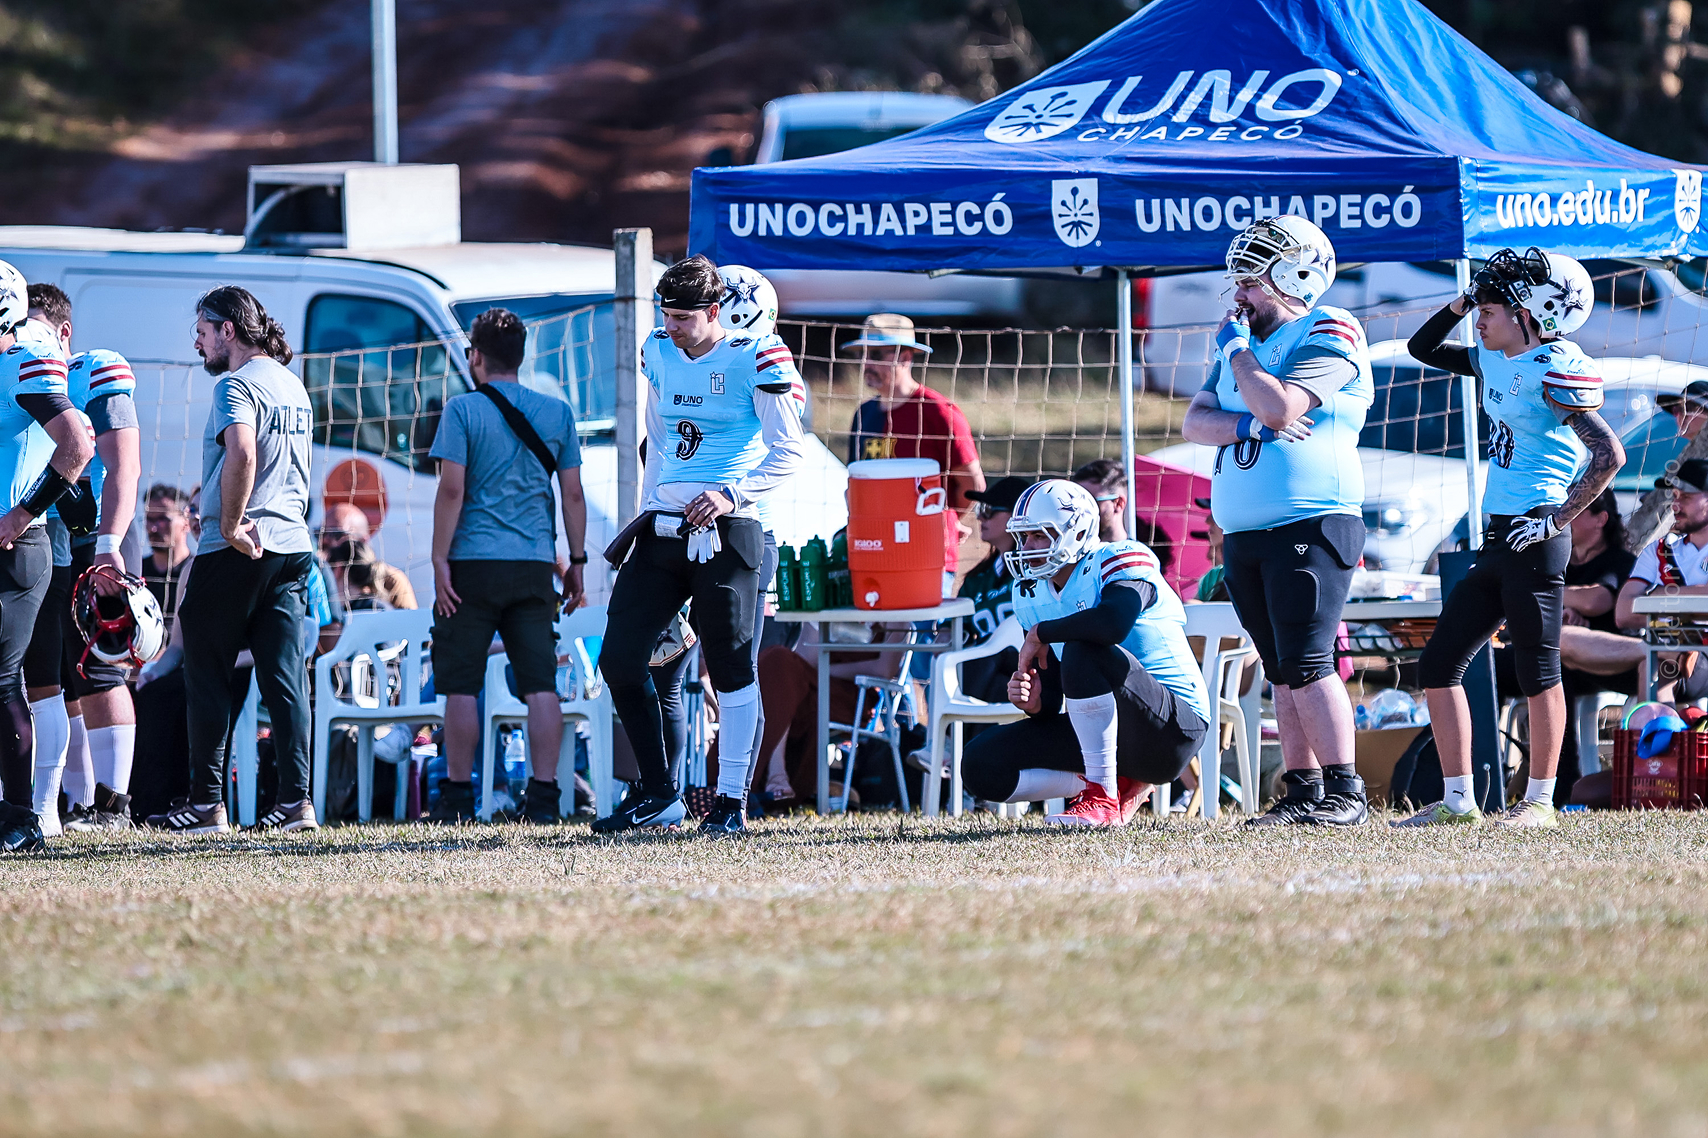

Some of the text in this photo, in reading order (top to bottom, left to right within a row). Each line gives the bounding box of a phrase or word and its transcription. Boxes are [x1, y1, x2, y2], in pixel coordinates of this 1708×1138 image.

[1101, 68, 1342, 123] UNO
[1077, 120, 1303, 142] CHAPECÓ
[728, 192, 1014, 237] UNOCHAPECÓ
[1135, 185, 1422, 233] UNOCHAPECÓ
[1496, 178, 1651, 229] uno.edu.br
[682, 395, 703, 404] UNO
[675, 419, 704, 461] 9
[854, 539, 882, 548] IGLOO
